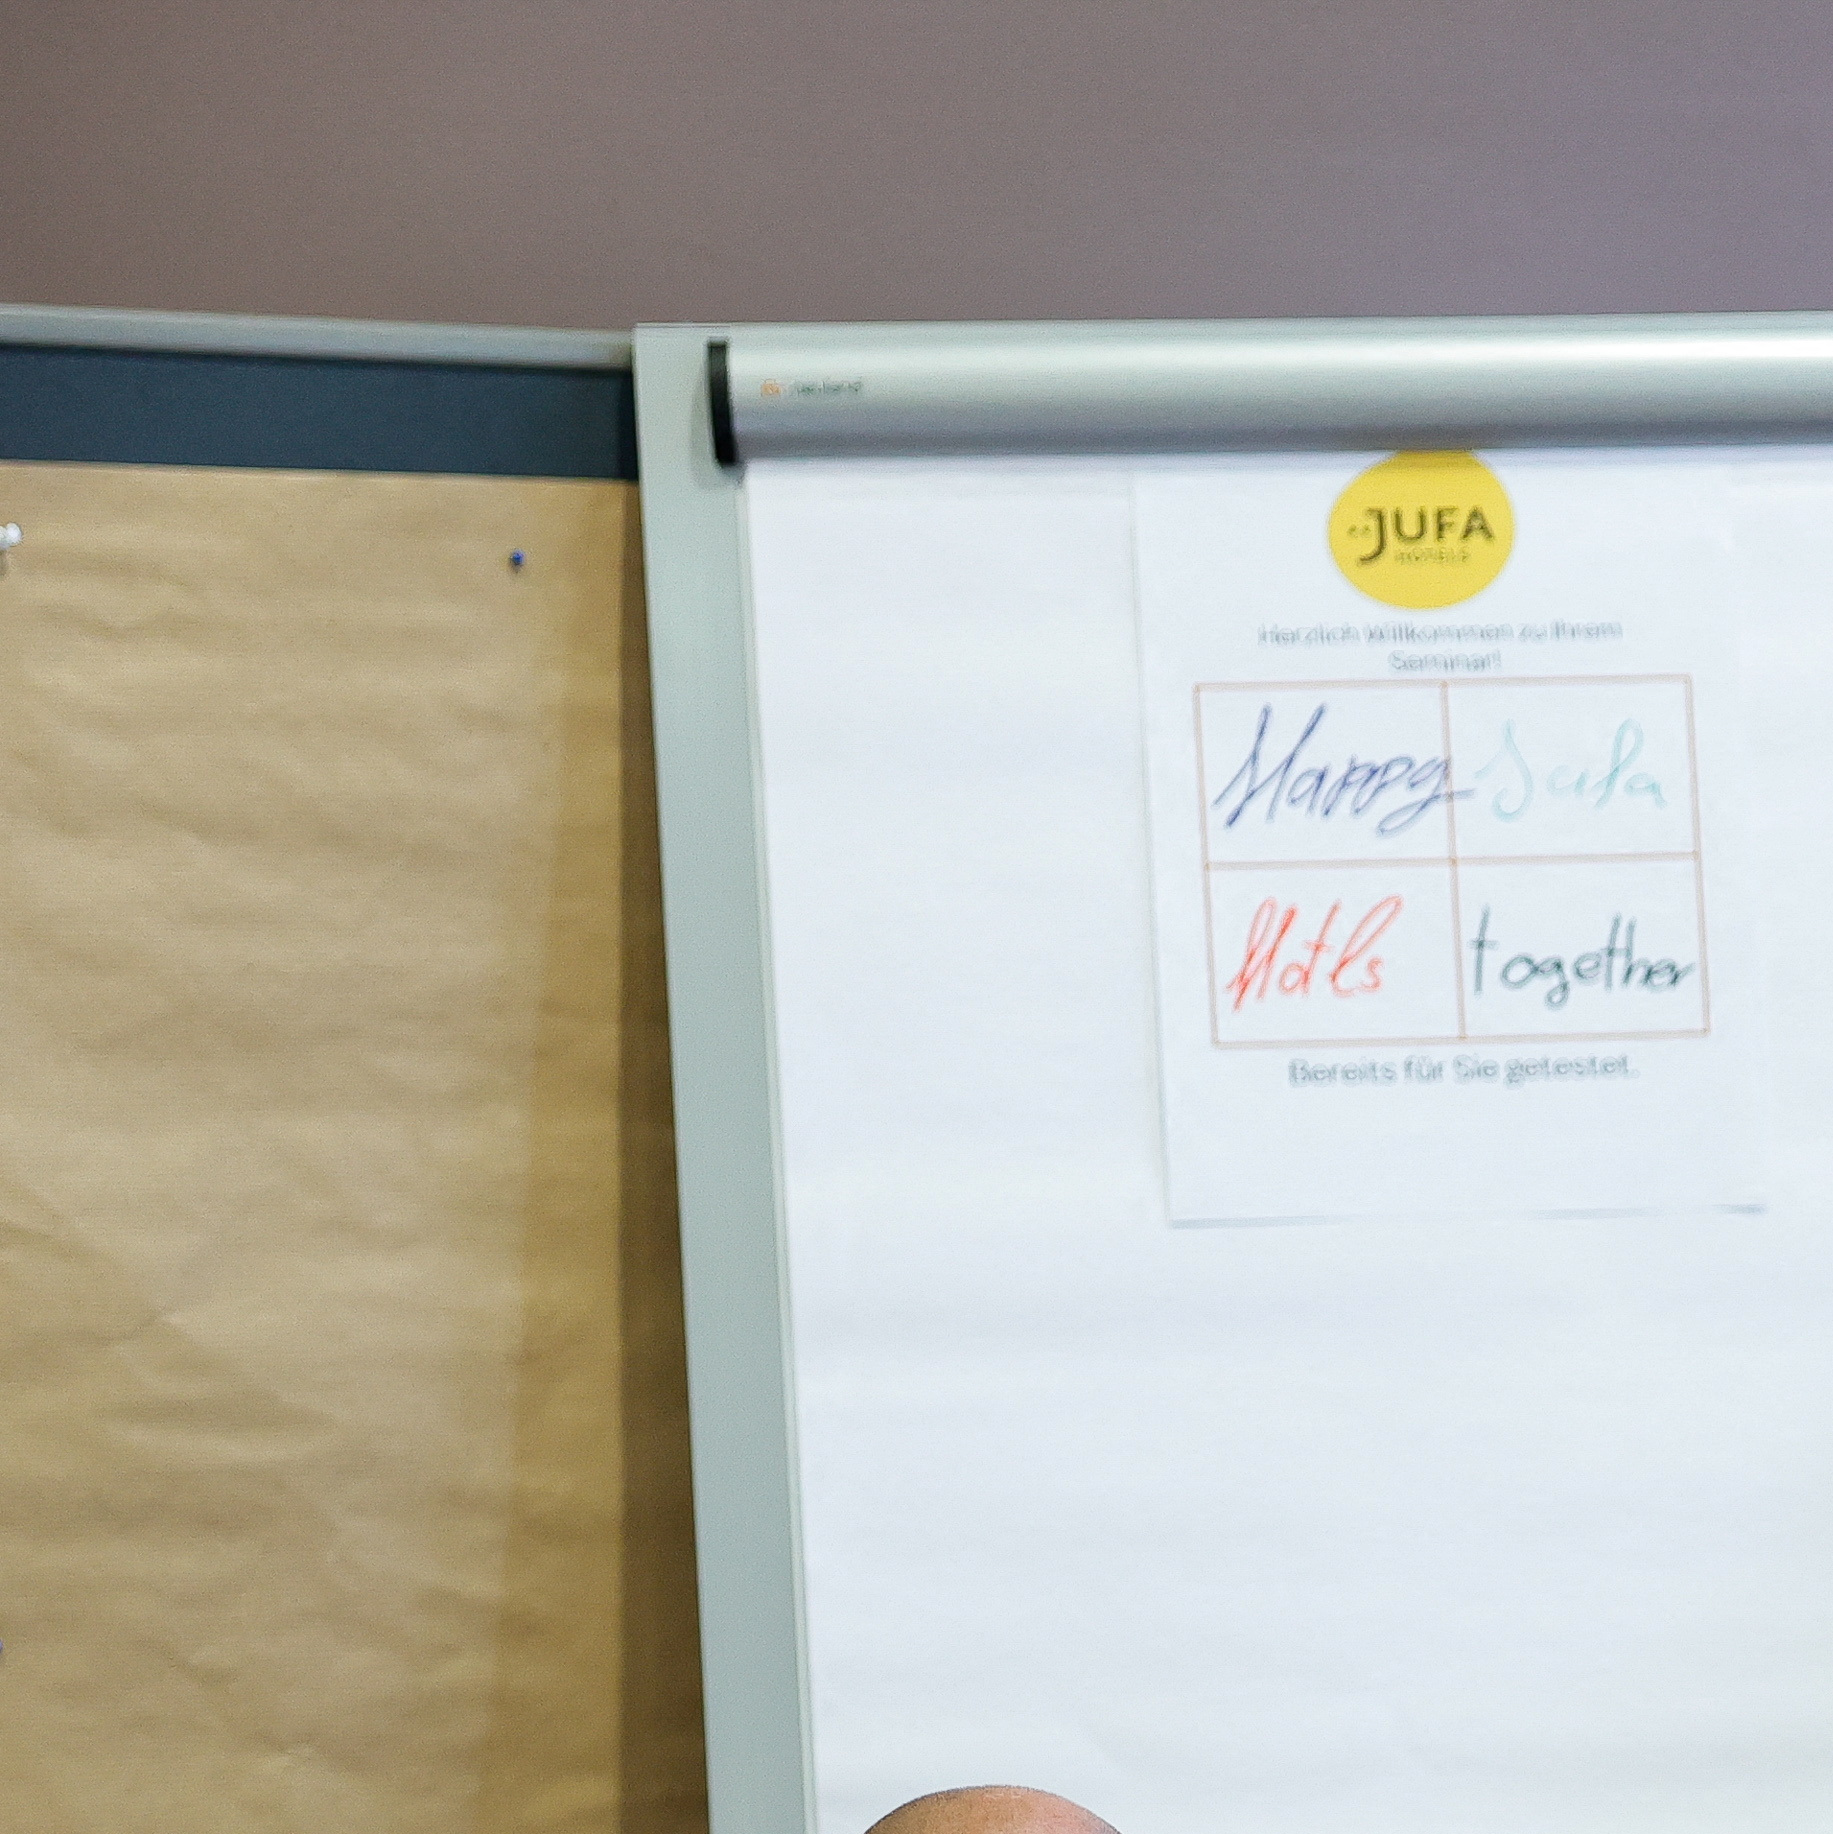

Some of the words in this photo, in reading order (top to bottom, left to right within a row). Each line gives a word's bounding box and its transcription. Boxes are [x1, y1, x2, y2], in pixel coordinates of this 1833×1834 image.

[1357, 504, 1495, 564] JUFA
[1287, 1057, 1398, 1088] Bereits
[1402, 1054, 1445, 1084] für
[1452, 1053, 1501, 1085] Sie
